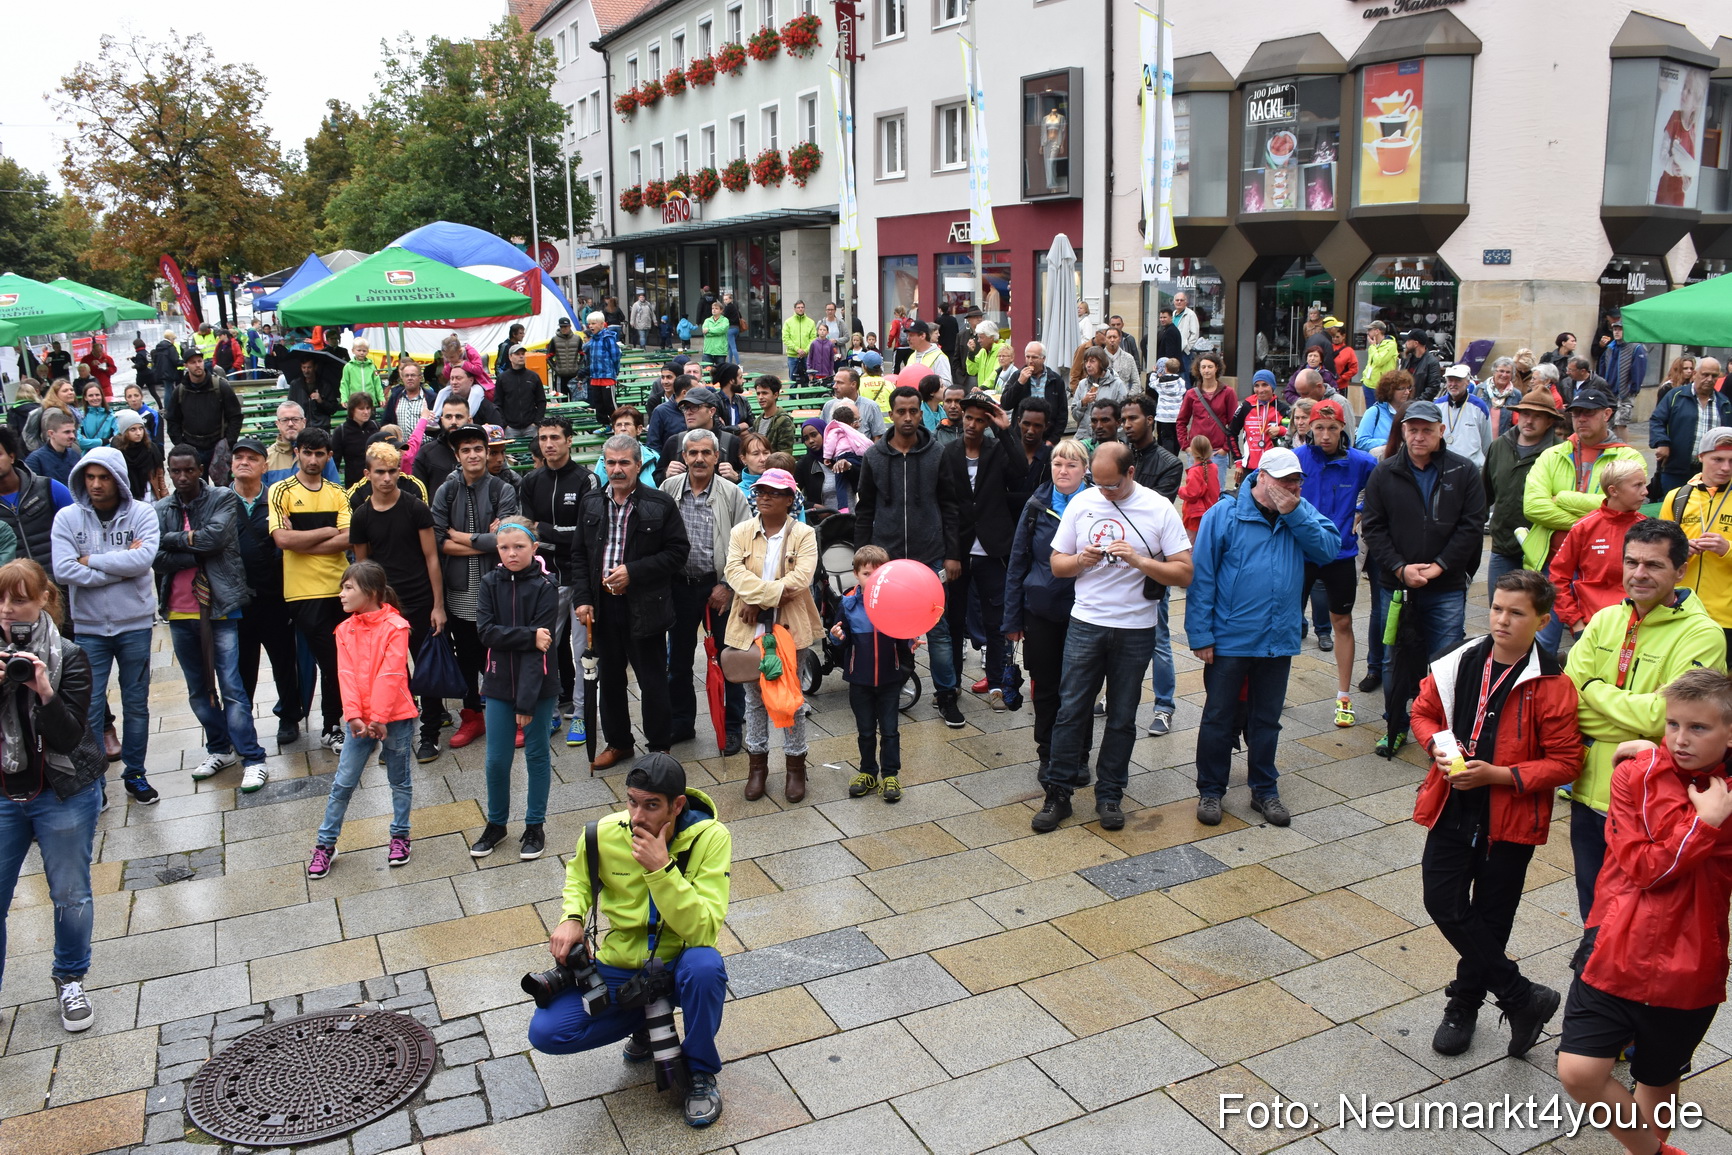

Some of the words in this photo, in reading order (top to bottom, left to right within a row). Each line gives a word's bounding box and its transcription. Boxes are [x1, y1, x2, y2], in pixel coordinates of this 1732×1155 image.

[1253, 88, 1267, 100] 100
[1267, 84, 1290, 98] Jahre
[661, 198, 691, 225] RENO
[1144, 263, 1163, 274] WC
[1395, 276, 1421, 290] RACKL
[368, 287, 441, 295] Neumarkter
[355, 292, 456, 303] Lammsbräu
